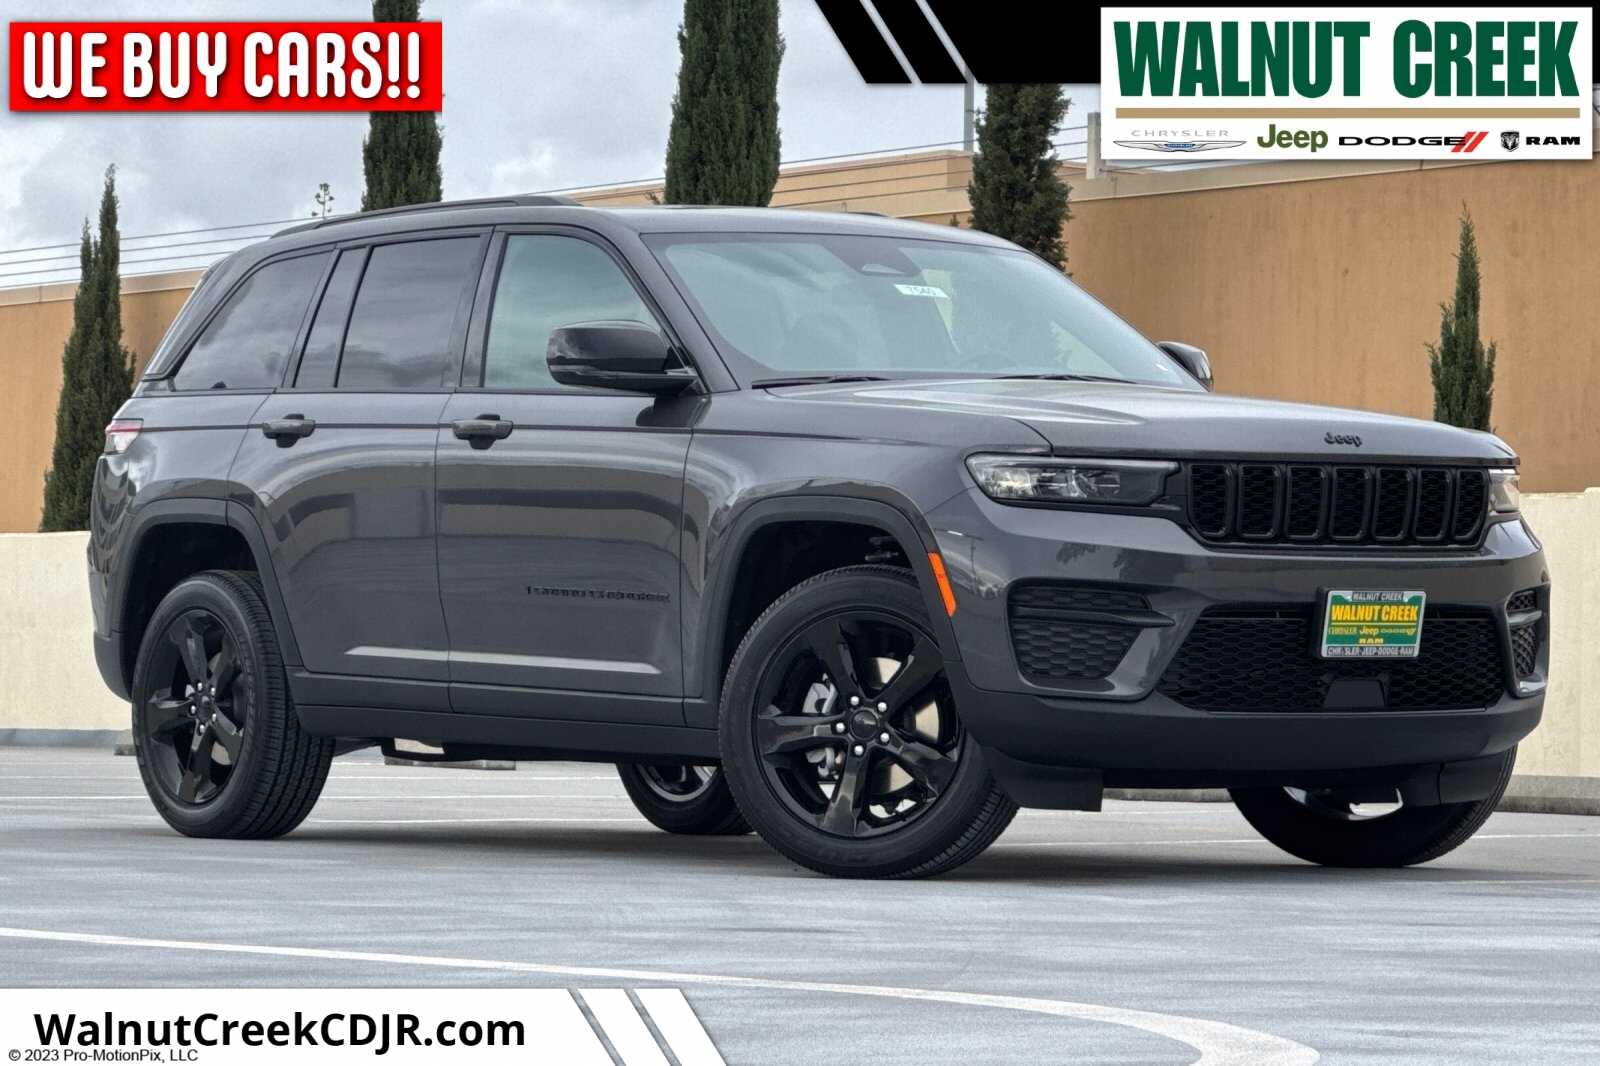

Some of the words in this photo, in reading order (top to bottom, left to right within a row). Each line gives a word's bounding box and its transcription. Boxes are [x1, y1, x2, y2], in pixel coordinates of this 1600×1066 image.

[1324, 432, 1363, 447] Jeep
[1353, 591, 1379, 601] WALNUT
[1380, 591, 1403, 601] CREEK
[1331, 604, 1380, 621] WALNUT
[1381, 604, 1418, 621] CREEK
[1359, 625, 1379, 637] Jeep
